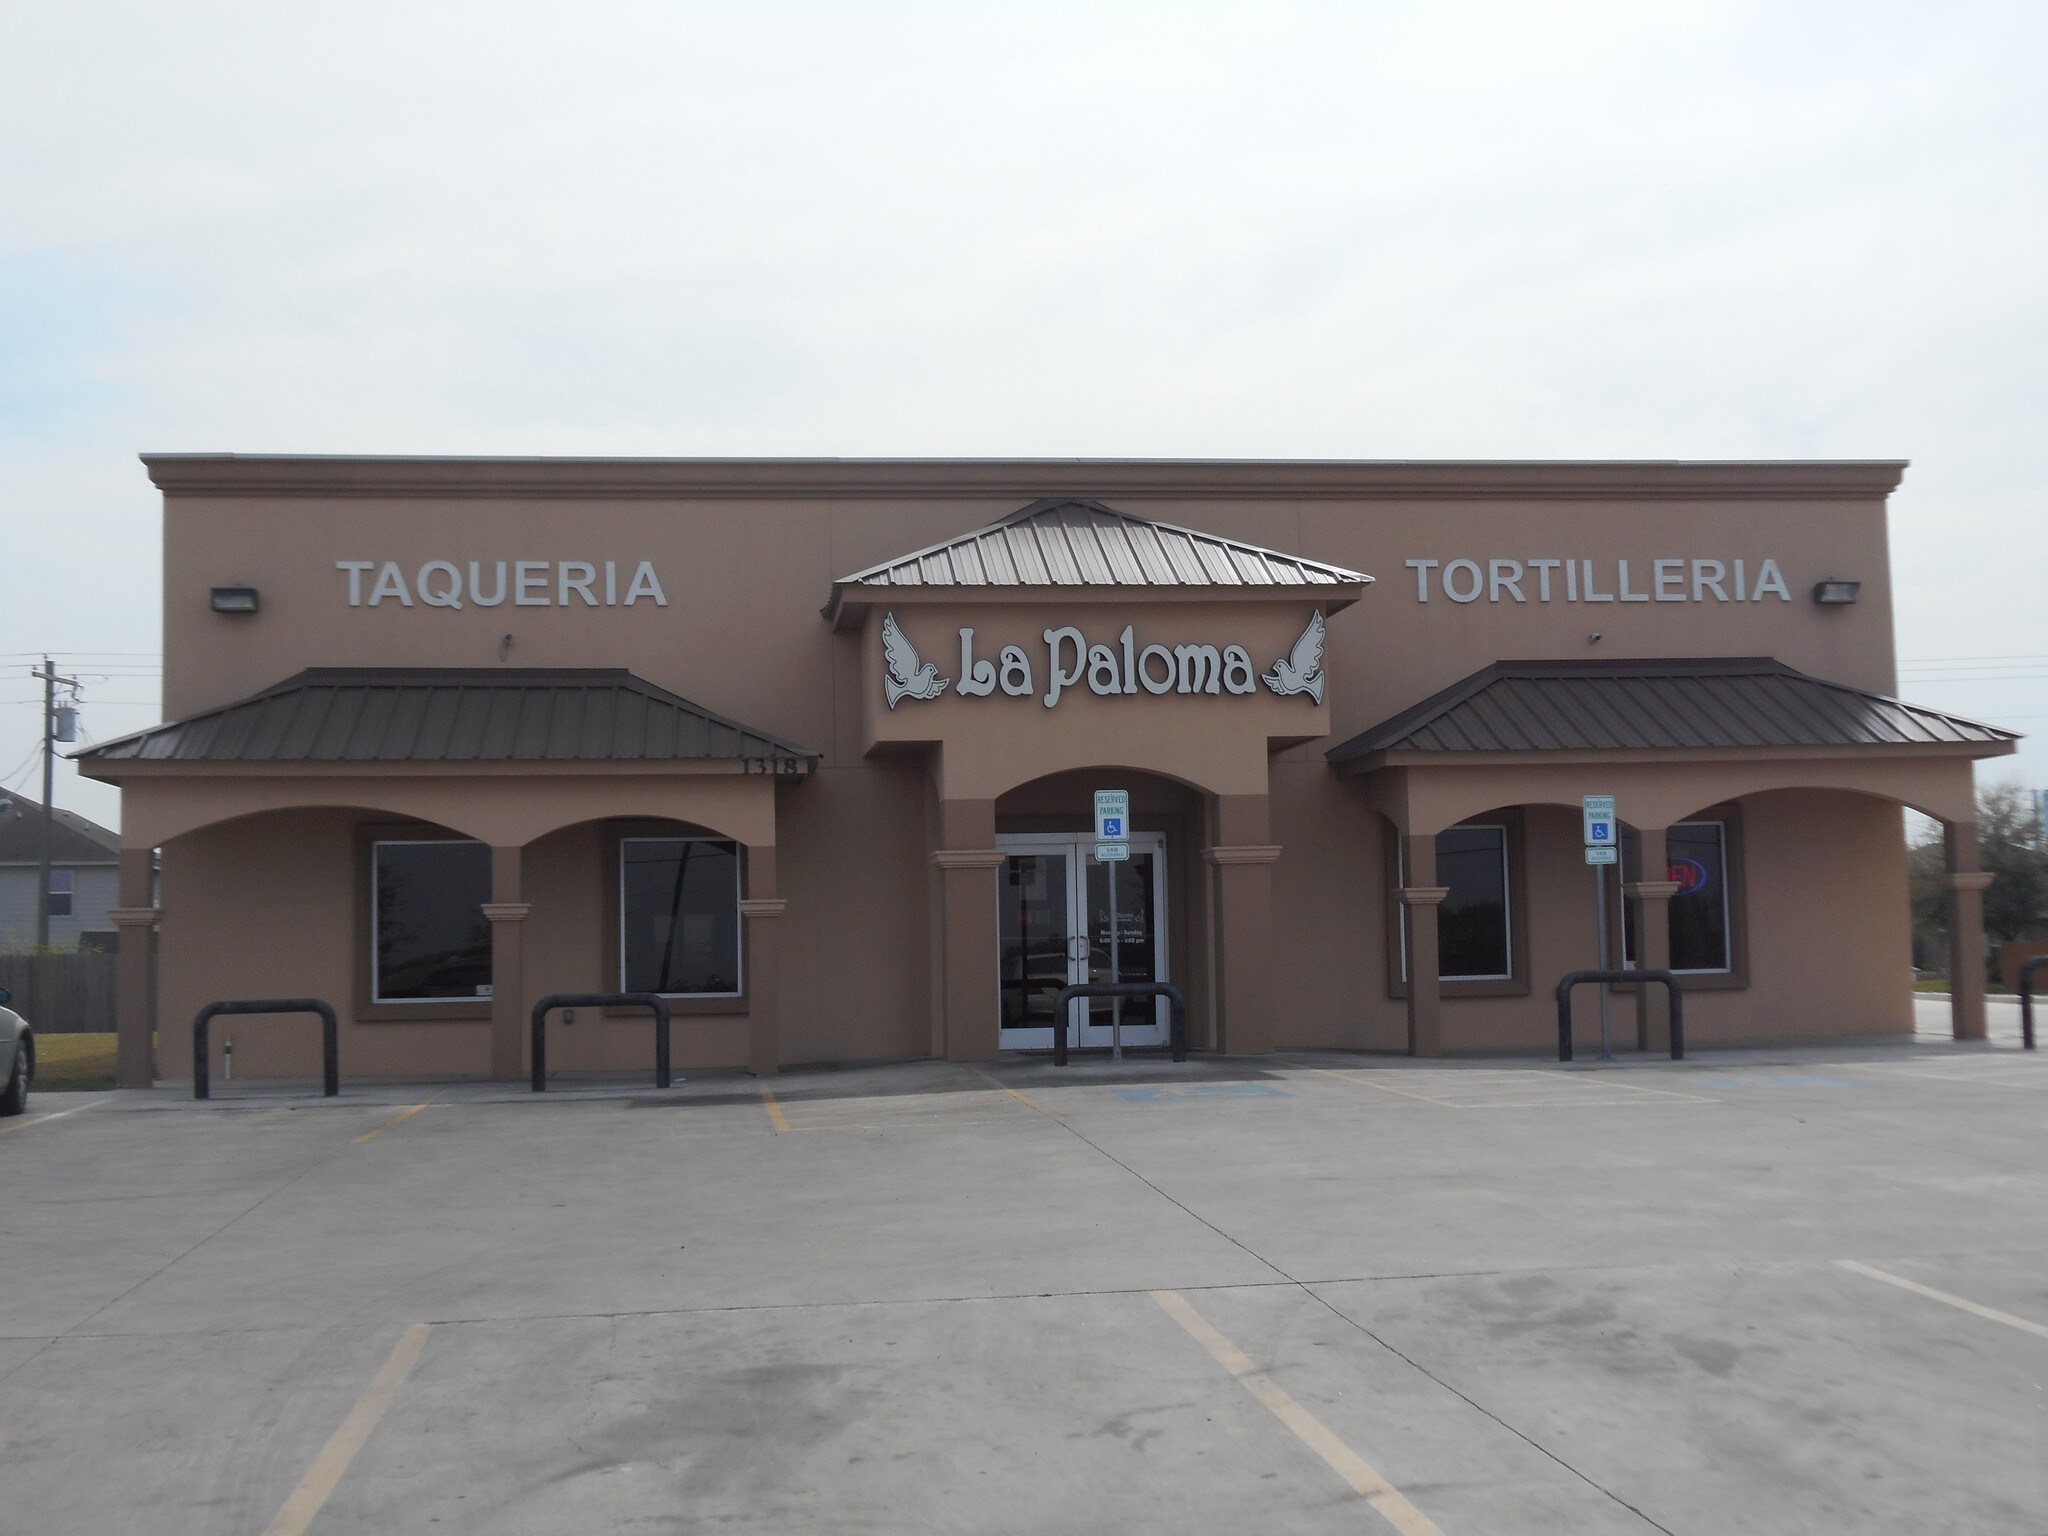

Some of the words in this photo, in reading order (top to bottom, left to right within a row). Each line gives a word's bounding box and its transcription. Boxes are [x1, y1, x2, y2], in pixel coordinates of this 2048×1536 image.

[335, 560, 668, 610] TAQUERIA
[1405, 558, 1792, 603] TORTILLERIA
[956, 627, 1034, 697] La
[1043, 624, 1257, 708] Paloma
[1097, 795, 1126, 804] RESERVED
[1584, 801, 1614, 809] RESERVED
[1099, 806, 1124, 815] PARKING
[1588, 811, 1611, 820] PARKING
